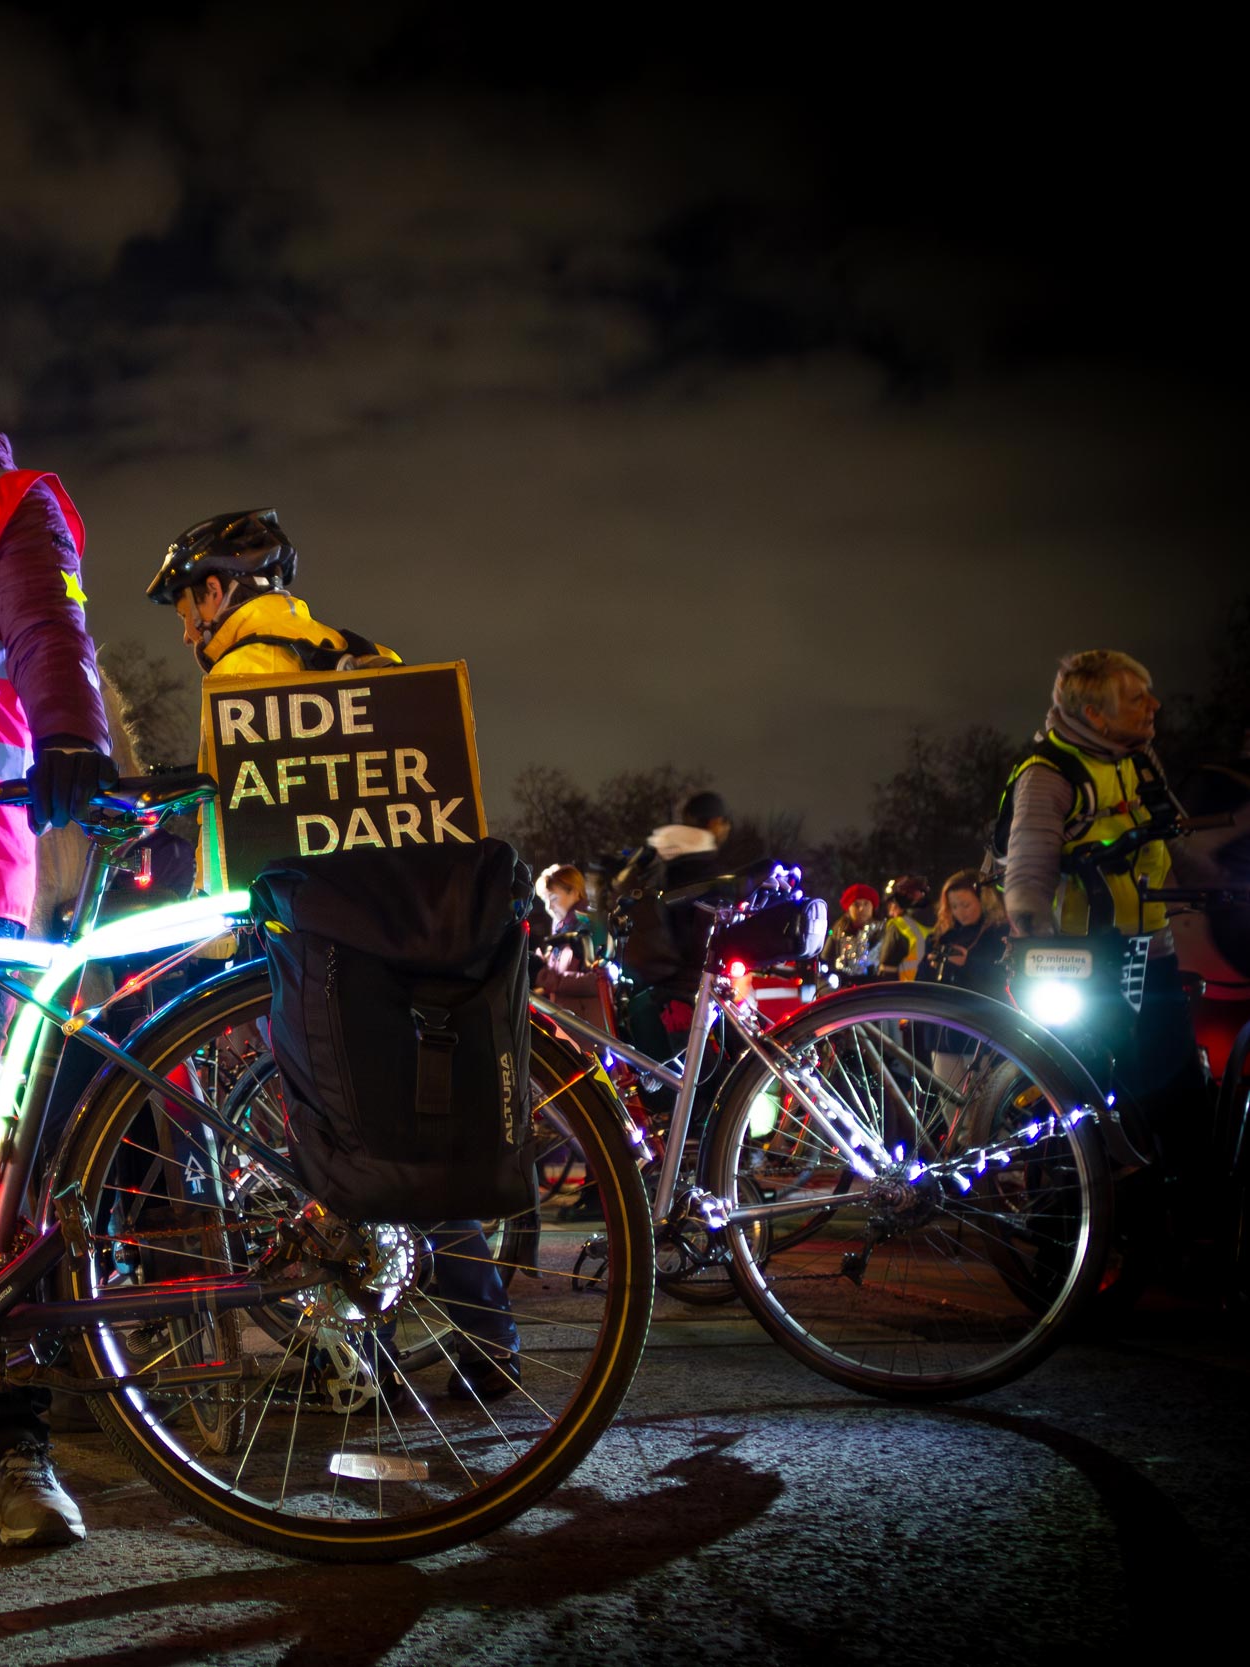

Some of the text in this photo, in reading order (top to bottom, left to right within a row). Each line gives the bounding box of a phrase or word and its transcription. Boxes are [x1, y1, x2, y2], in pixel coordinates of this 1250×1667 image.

[218, 687, 374, 745] RIDE
[228, 748, 436, 809] AFTER
[296, 797, 476, 856] DARK
[1031, 954, 1087, 964] 10 minutes
[500, 1051, 514, 1145] ALTURA
